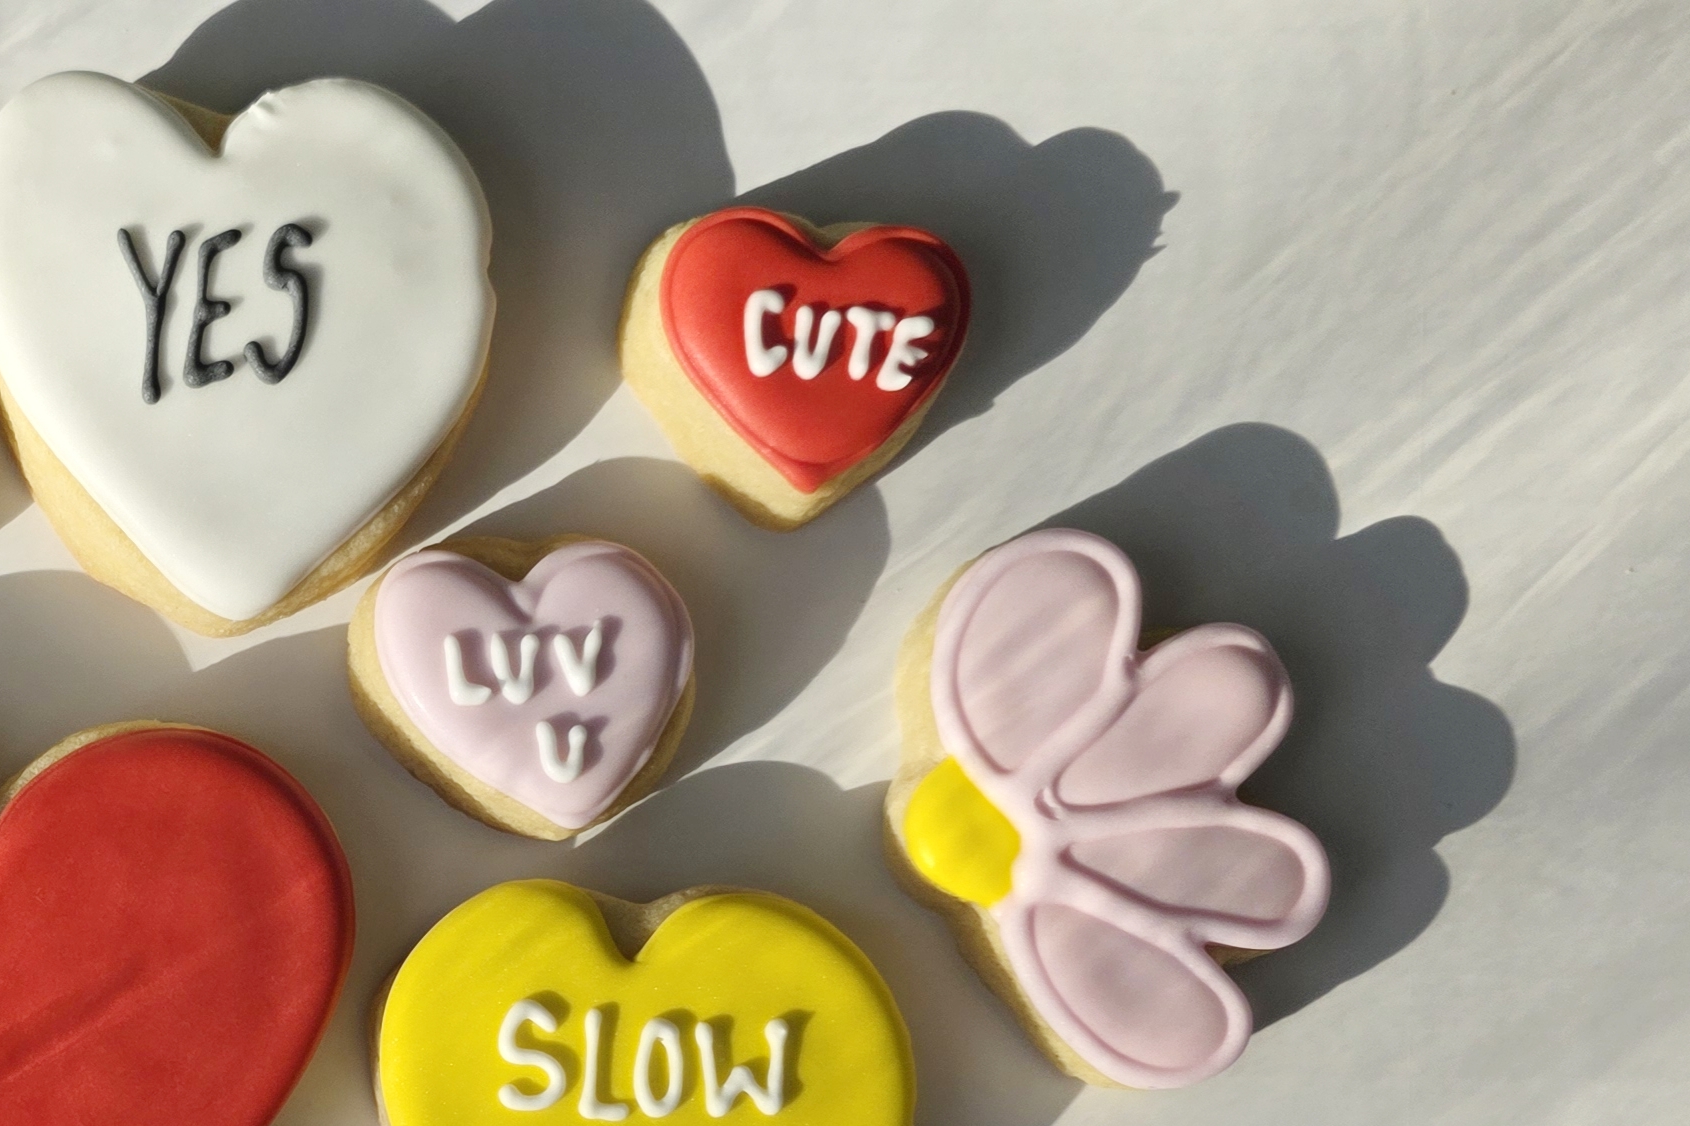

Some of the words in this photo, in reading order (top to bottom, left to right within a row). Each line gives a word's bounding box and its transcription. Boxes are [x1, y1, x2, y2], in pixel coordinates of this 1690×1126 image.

[116, 222, 313, 405] YES
[743, 288, 934, 392] CUTE
[535, 720, 588, 784] U
[497, 998, 788, 1120] SLOW
